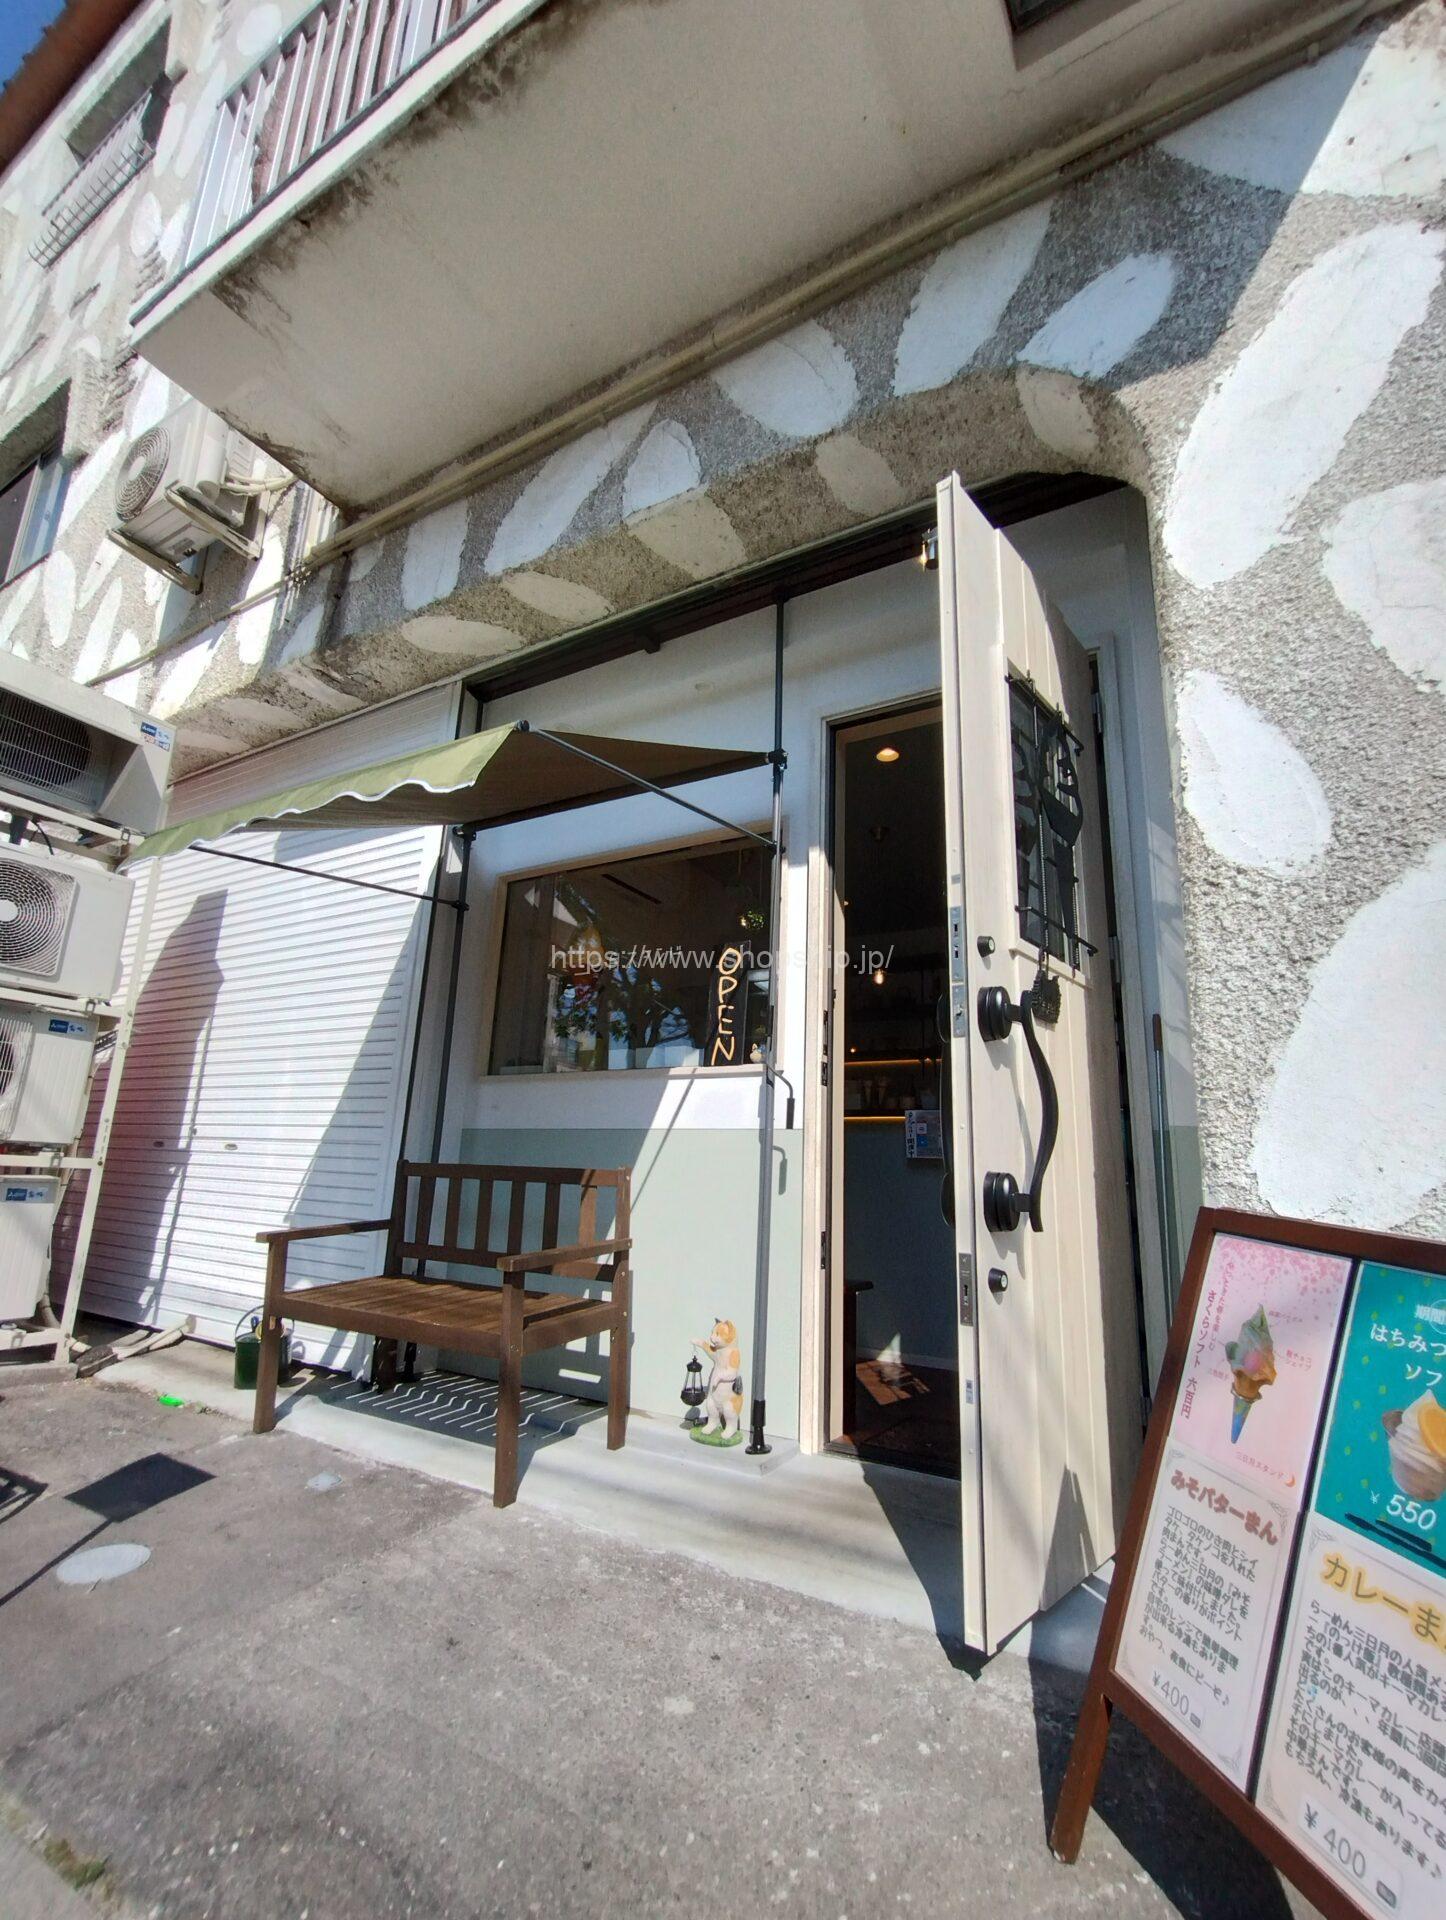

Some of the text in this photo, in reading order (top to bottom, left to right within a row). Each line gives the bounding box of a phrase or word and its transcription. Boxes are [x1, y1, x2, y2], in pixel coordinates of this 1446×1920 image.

[710, 946, 744, 1066] OPEN
[1180, 1290, 1217, 1419] さくらソフト 六百円
[1170, 1469, 1278, 1545] みそバターまん
[1322, 1550, 1446, 1651] カレーま
[1322, 1821, 1368, 1883] 400
